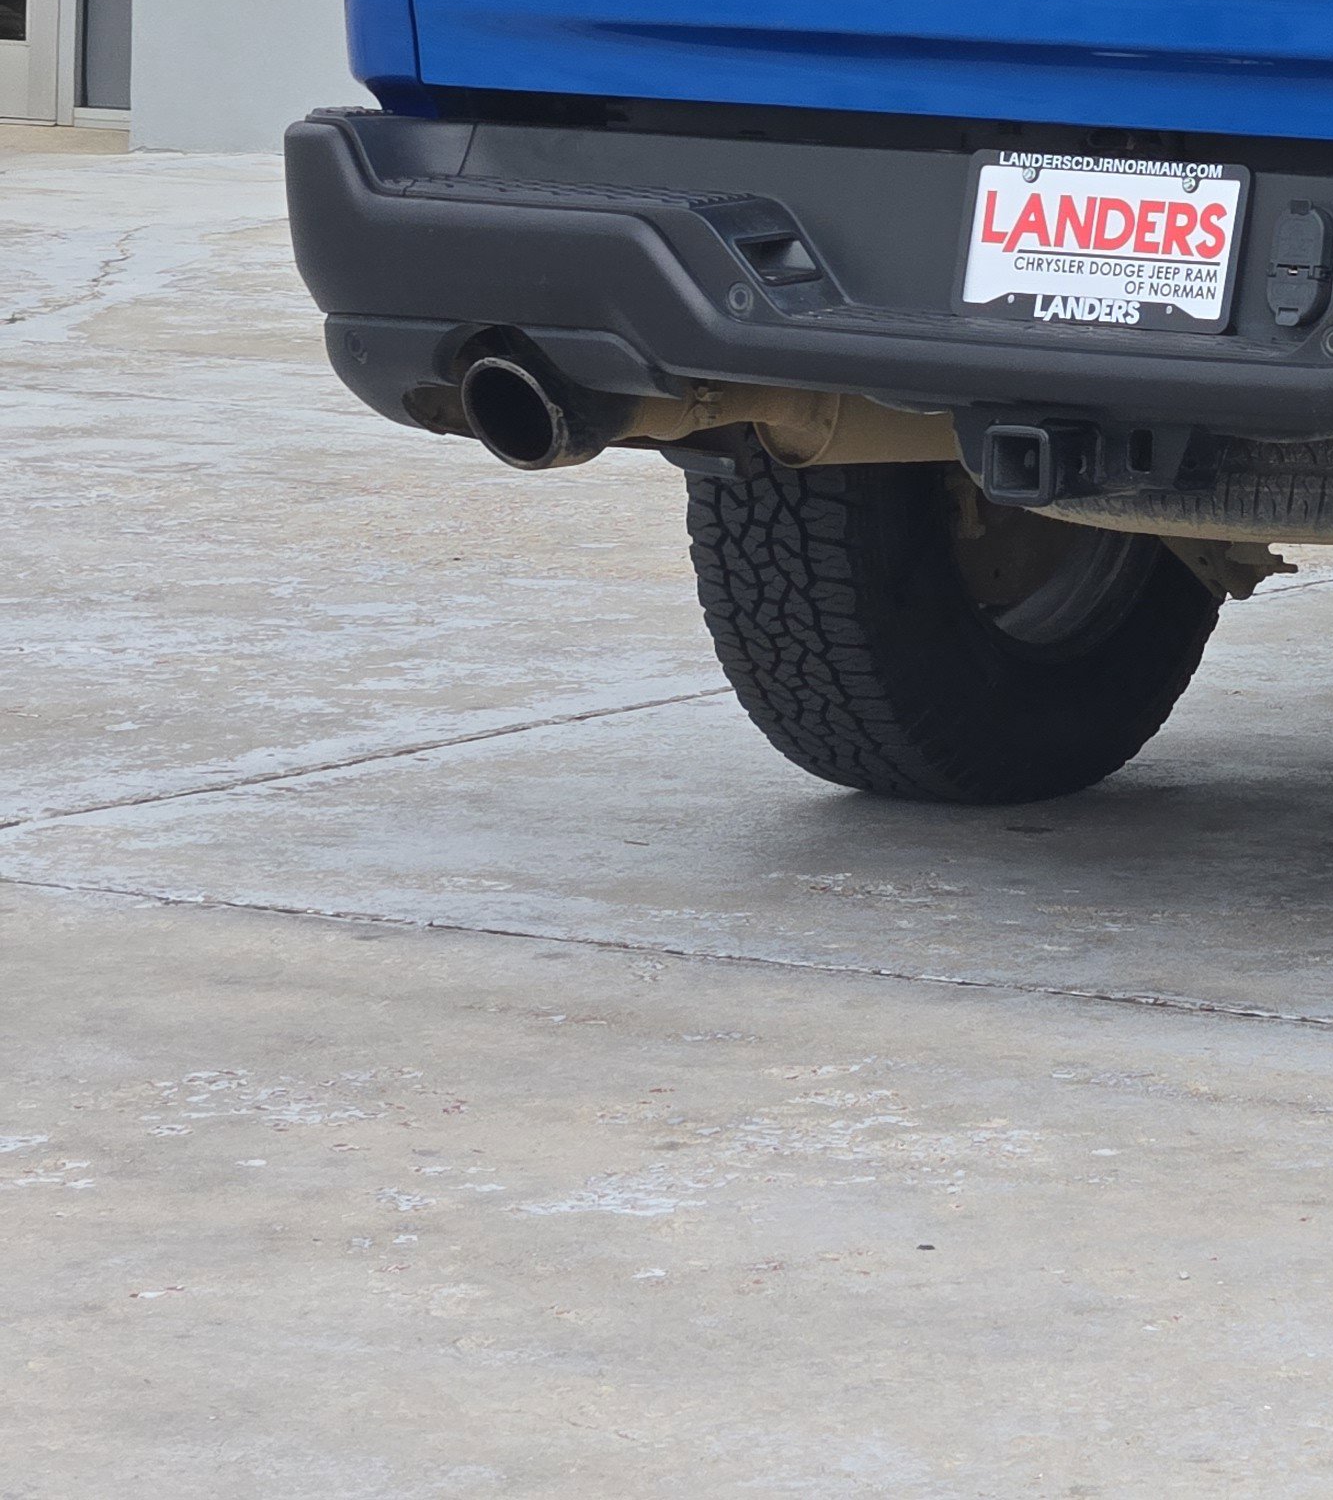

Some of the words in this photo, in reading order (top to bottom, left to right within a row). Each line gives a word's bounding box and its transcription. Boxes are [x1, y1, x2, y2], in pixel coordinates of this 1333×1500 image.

[999, 151, 1223, 179] LANDERSCDJRNORMAN.COM
[981, 190, 1228, 259] LANDERS
[1014, 256, 1085, 275] CHRYSLER
[1089, 261, 1145, 278] DODGE
[1148, 265, 1181, 283] JEEP
[1184, 268, 1218, 284] RAM
[1124, 280, 1145, 295] OF
[1148, 282, 1217, 301] NORMAN
[1034, 294, 1140, 325] LANDERS
